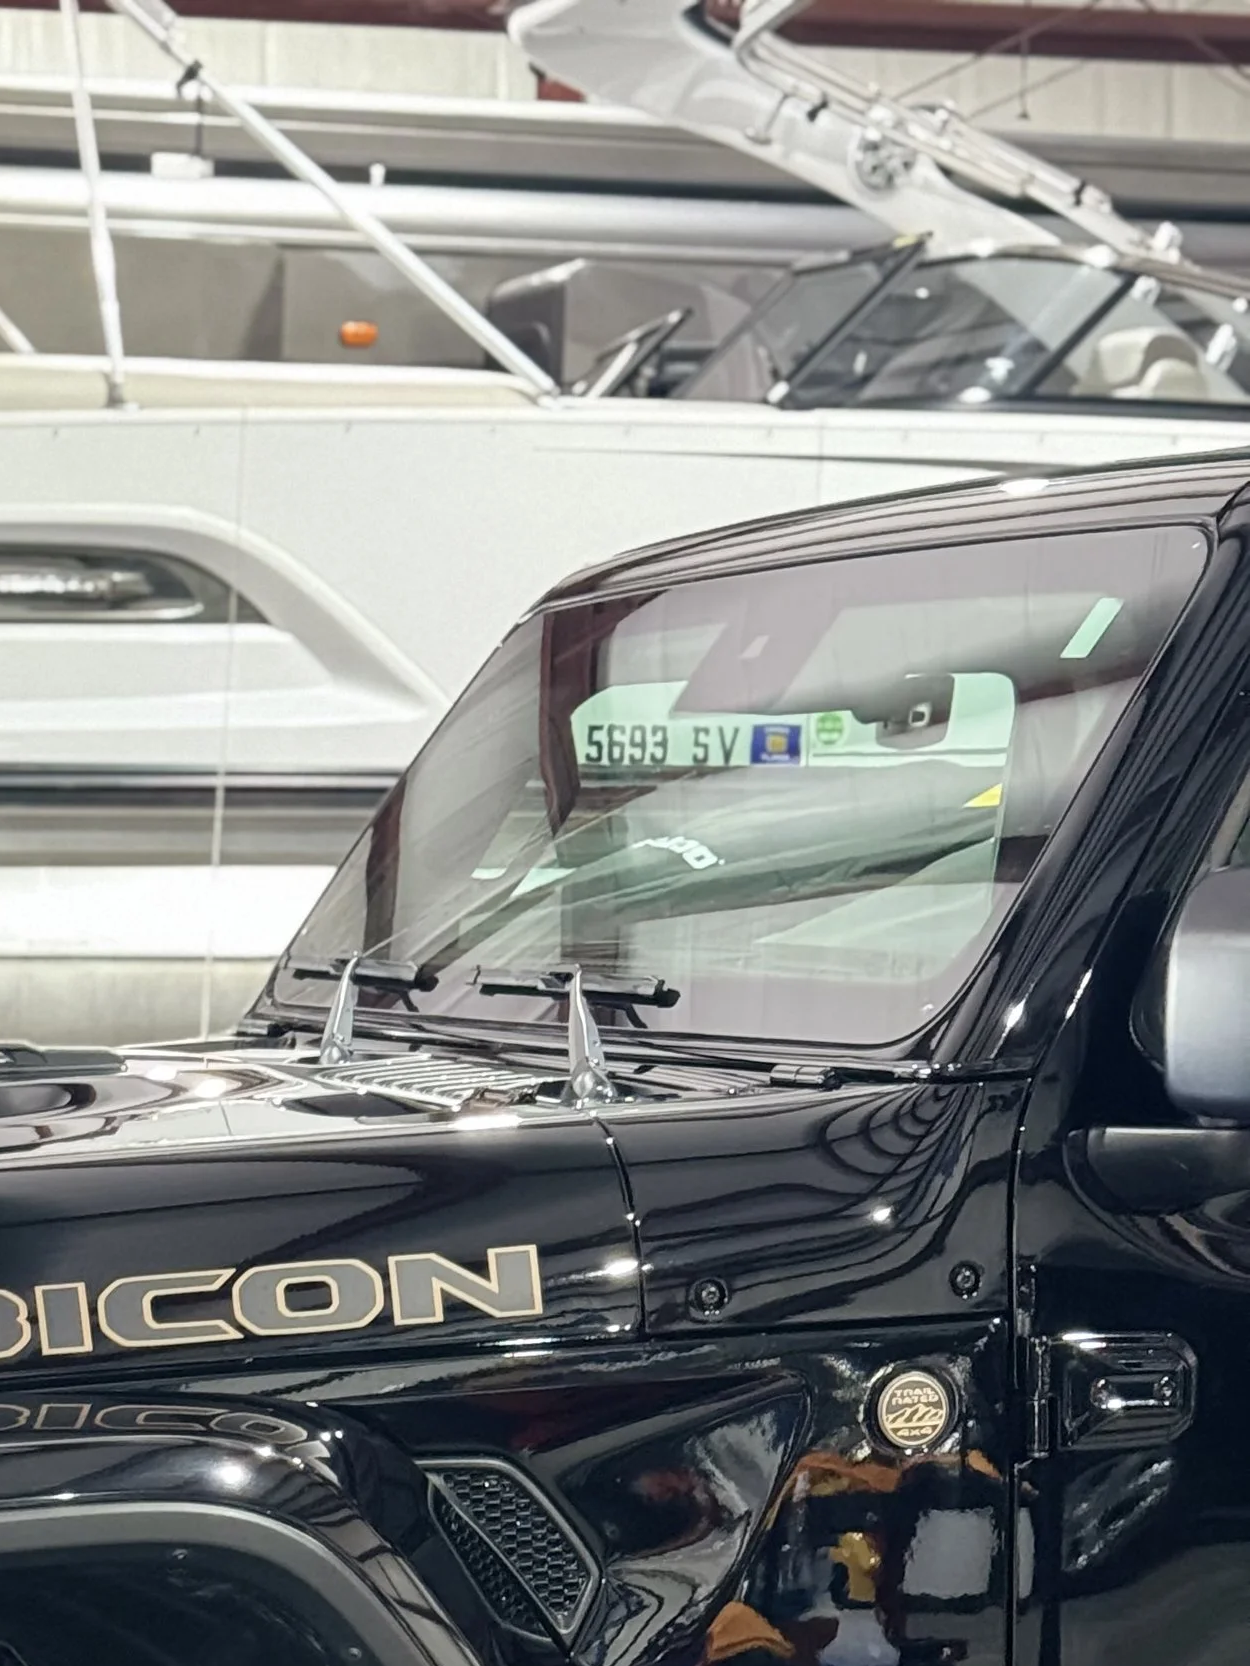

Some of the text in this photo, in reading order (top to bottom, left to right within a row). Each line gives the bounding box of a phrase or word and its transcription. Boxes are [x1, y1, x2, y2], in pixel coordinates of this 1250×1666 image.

[584, 723, 669, 765] 5693
[893, 1387, 936, 1397] TRAIL
[891, 1394, 939, 1406] RATED
